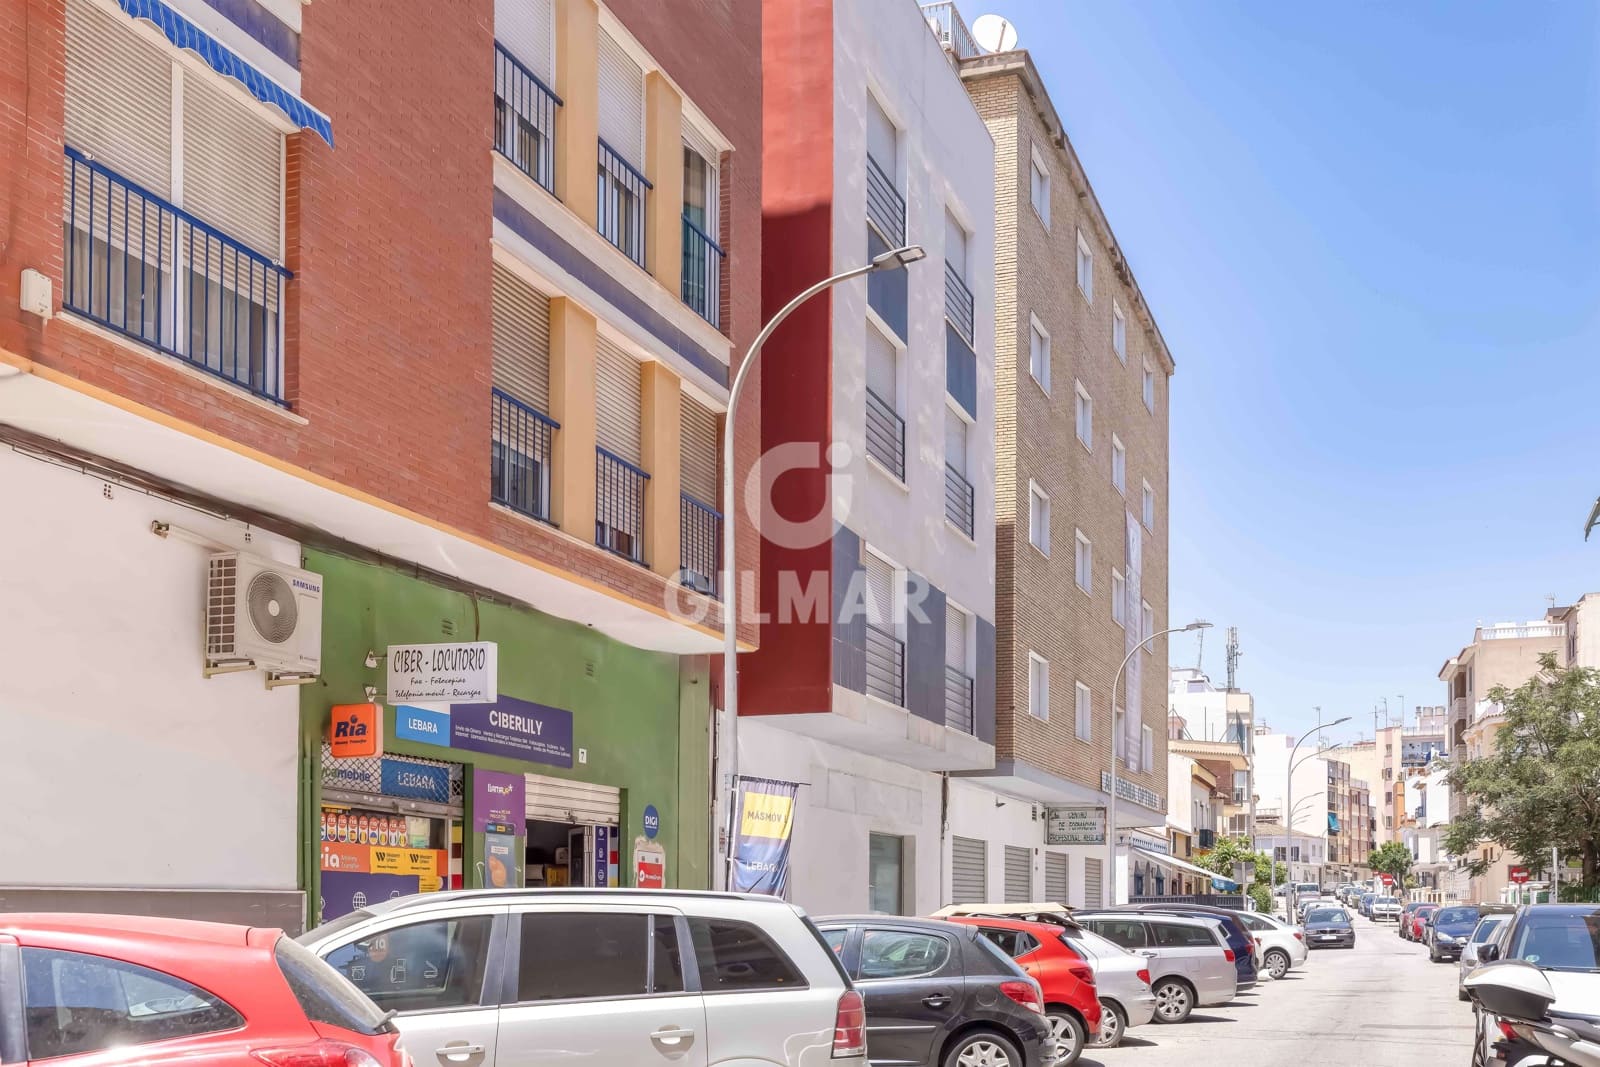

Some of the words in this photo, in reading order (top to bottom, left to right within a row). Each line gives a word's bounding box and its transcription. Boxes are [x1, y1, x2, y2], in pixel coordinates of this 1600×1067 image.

[292, 579, 320, 593] SAMSUNG
[393, 649, 423, 674] CIBER
[432, 647, 486, 672] LOCUTORIO
[410, 677, 422, 685] Fax
[430, 676, 466, 685] Fotocopias
[452, 688, 481, 698] Recargas
[335, 714, 367, 738] Ria
[408, 717, 438, 734] LEBARA
[489, 710, 543, 736] CIBERLILY
[580, 751, 585, 760] 7
[645, 815, 658, 826] DIGI
